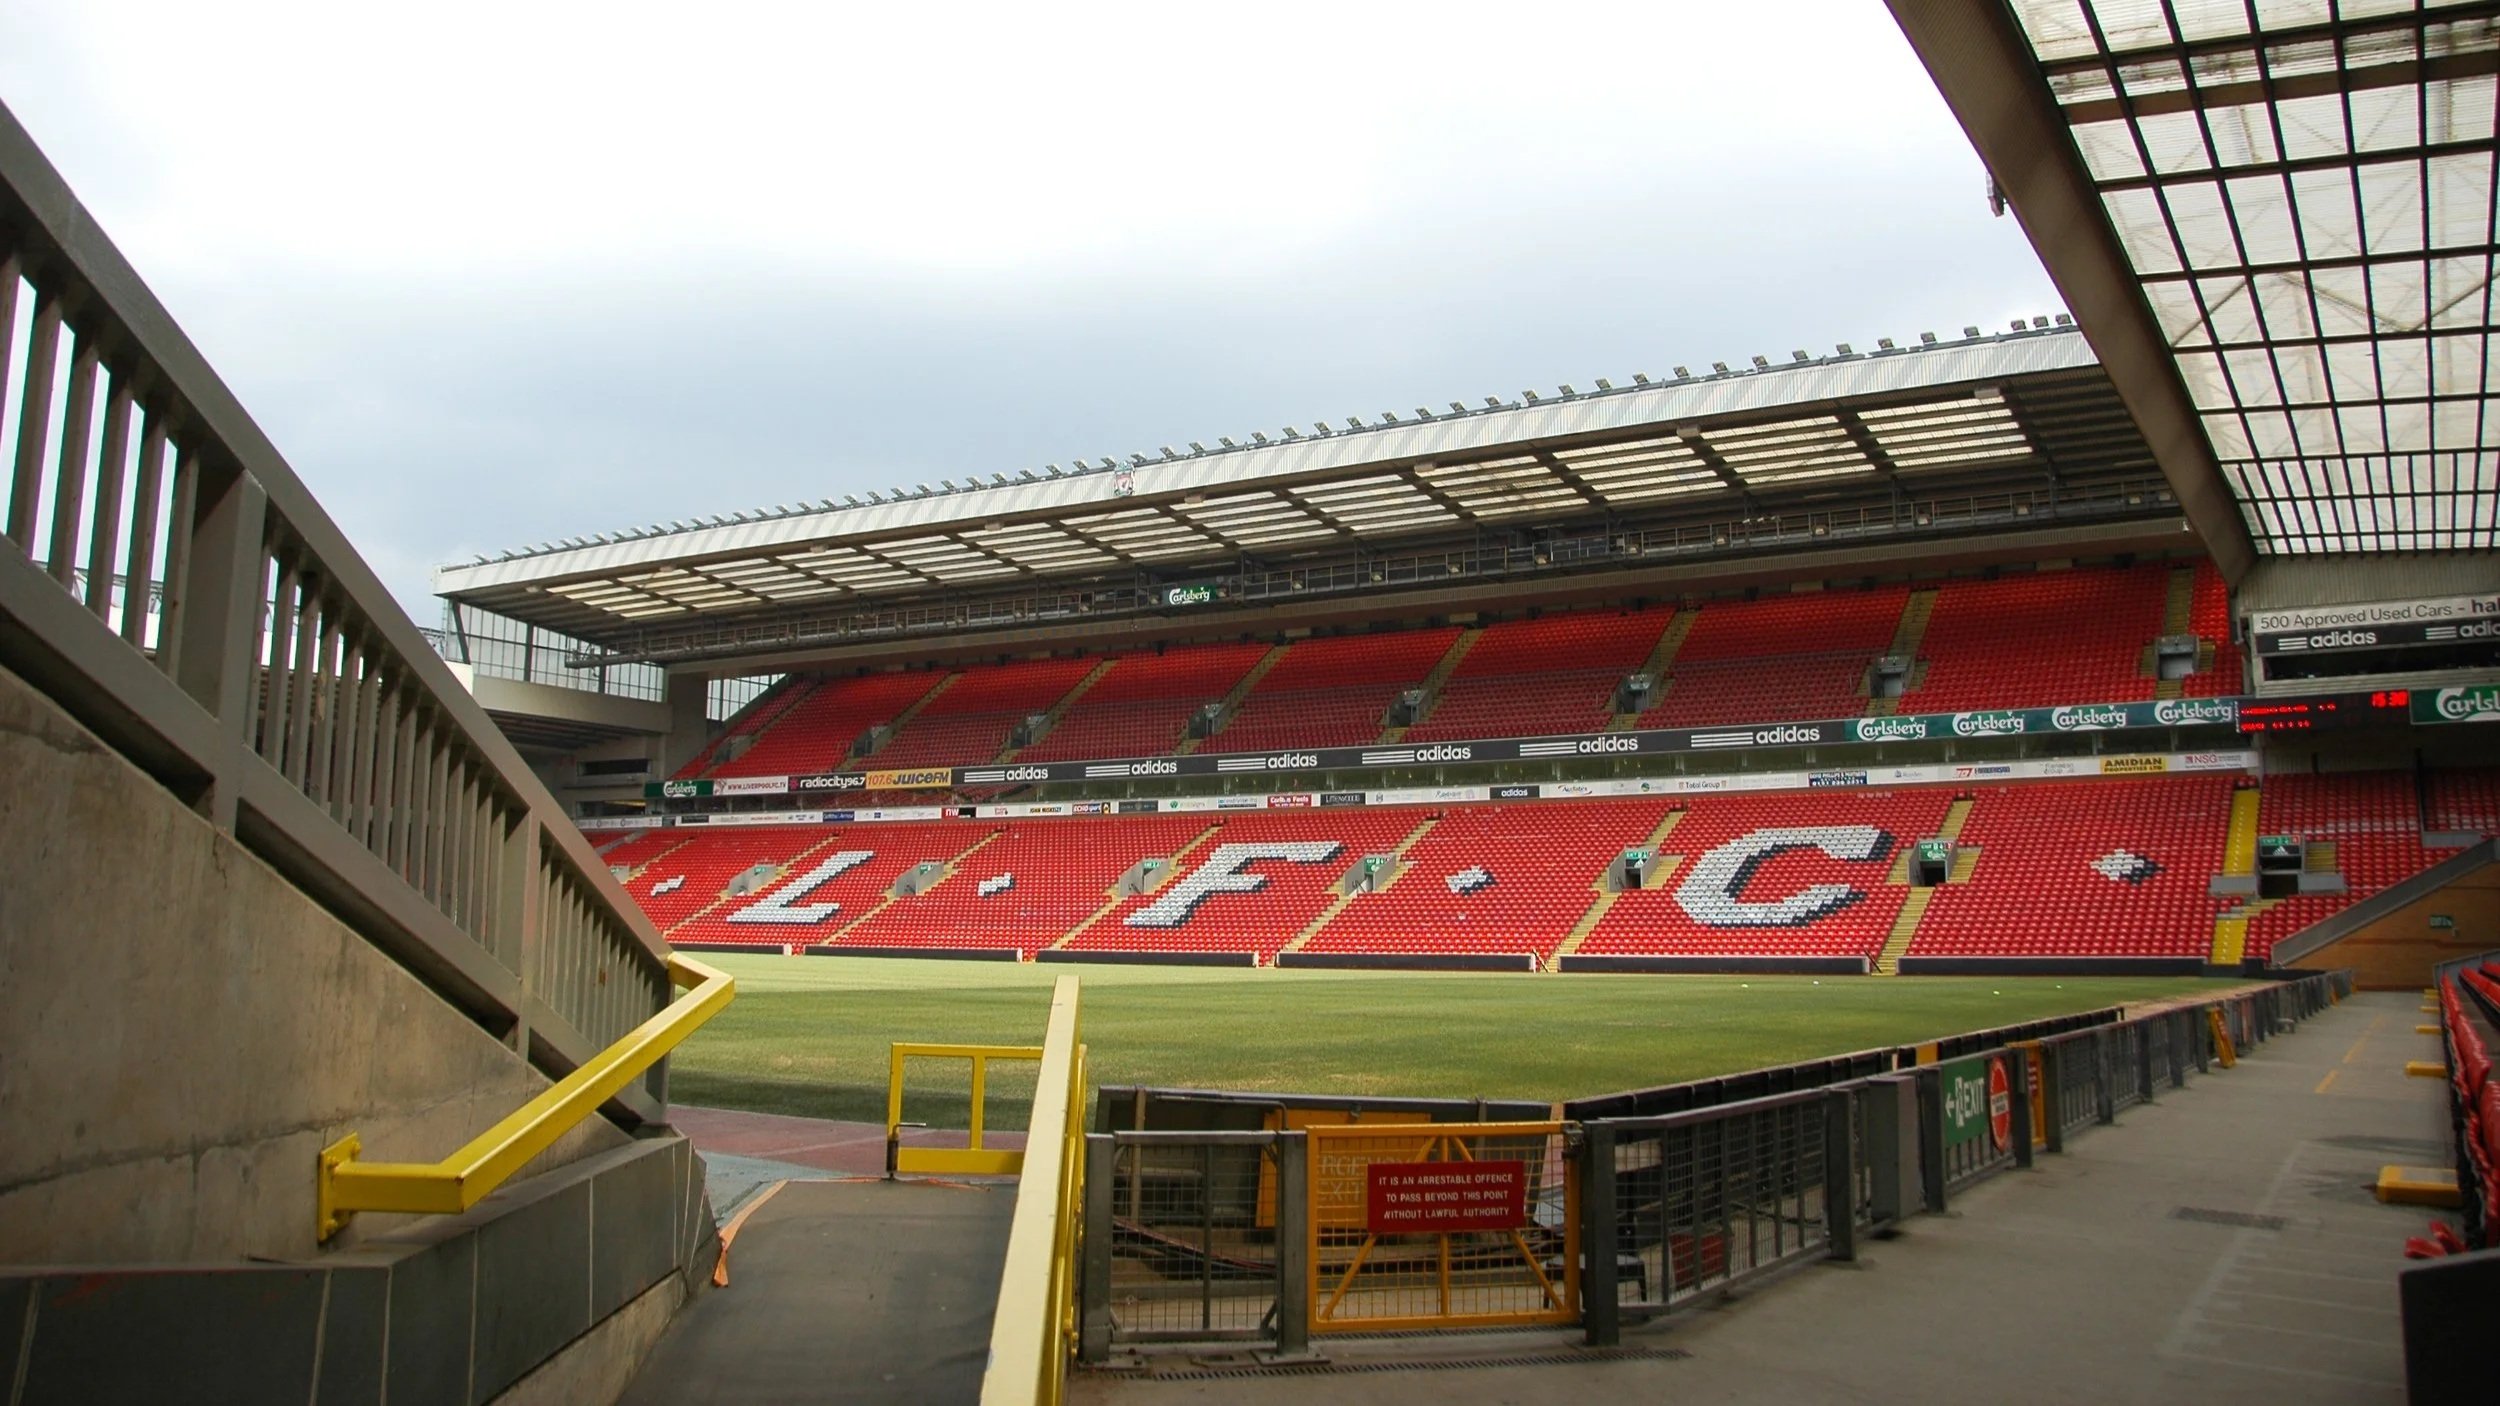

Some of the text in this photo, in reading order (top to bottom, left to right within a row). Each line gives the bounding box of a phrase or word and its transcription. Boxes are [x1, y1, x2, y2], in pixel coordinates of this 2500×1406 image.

[1169, 587, 1210, 605] Carlsberg
[2261, 615, 2289, 629] 500
[2294, 609, 2366, 628] Approved
[2370, 606, 2411, 621] Used
[2416, 604, 2452, 618] Cars
[2310, 631, 2377, 648] adidas
[2052, 705, 2127, 731] Carlsberg
[2155, 700, 2232, 725] Carlsberg
[1857, 717, 1926, 741] Carlsberg
[1953, 711, 2025, 736] Carlsberg
[1756, 726, 1820, 744] adidas
[1579, 736, 1638, 753] adidas
[1268, 753, 1318, 769] adidas
[1416, 745, 1471, 761] adidas
[2194, 754, 2217, 763] NSG
[1131, 760, 1177, 775] adidas
[2104, 758, 2162, 767] AMIDIAN
[868, 774, 893, 785] 107.6
[1006, 767, 1049, 780] adidas
[663, 780, 697, 797] Carlsberg
[1501, 789, 1528, 797] adidas
[1701, 781, 1721, 789] Group
[727, 825, 1890, 928] L F C
[1964, 1077, 1984, 1118] EXIT
[1379, 1173, 1513, 1185] IT IS AN ARRESTABLE OFFENCE
[1386, 1190, 1509, 1202] TO PASS BEYOND THIS POINT
[1384, 1207, 1509, 1219] WITHOUT LAWFUL AUTHORITY
